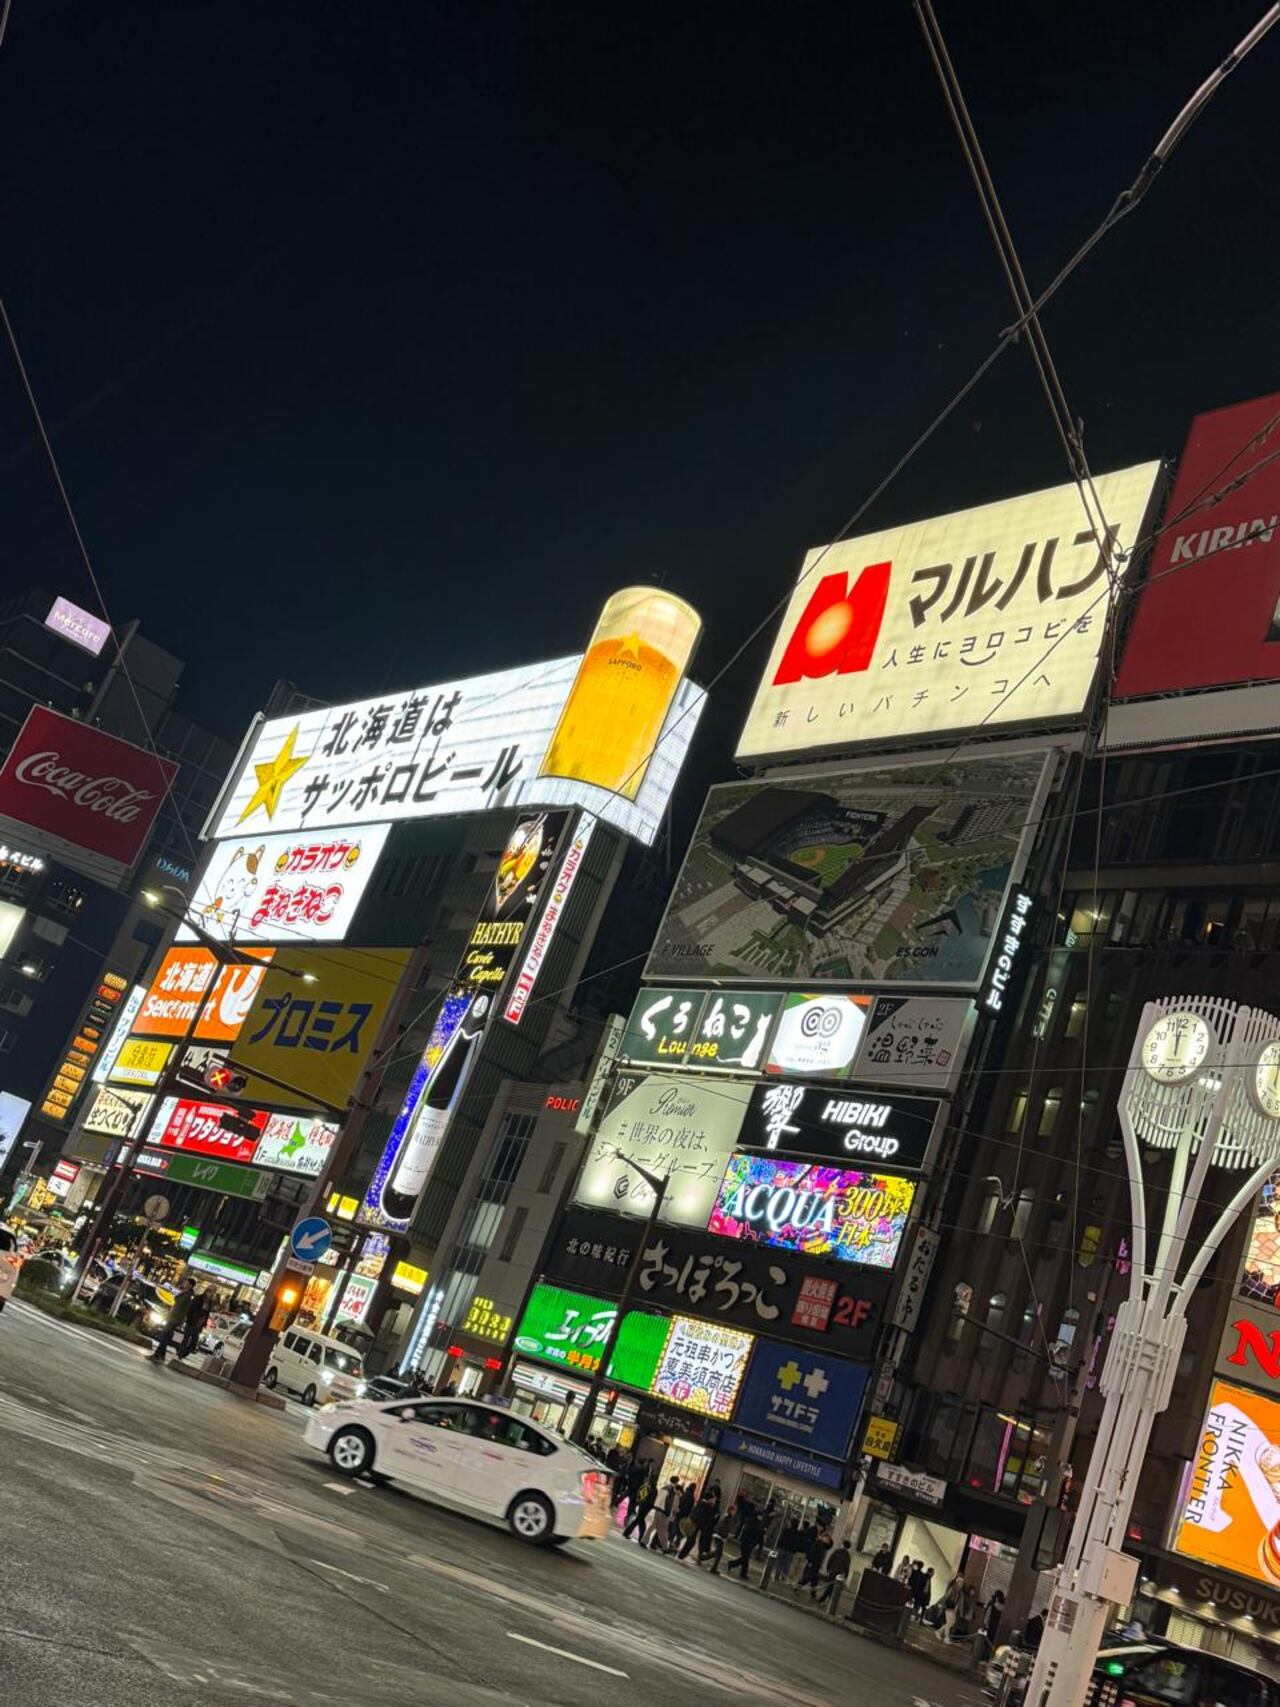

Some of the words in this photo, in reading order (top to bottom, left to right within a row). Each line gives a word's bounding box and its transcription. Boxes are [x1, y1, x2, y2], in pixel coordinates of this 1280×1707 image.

[1170, 515, 1278, 563] KIRIN
[909, 524, 1121, 628] マルハン
[882, 616, 1092, 668] 人生にヨロコビを
[608, 658, 642, 671] SAPPORO
[773, 674, 1050, 728] 新しいパチンコへ
[322, 690, 462, 757] 北海道は
[15, 752, 157, 822] Coca-Cola
[300, 744, 524, 818] サッポロビール
[286, 843, 349, 873] カラオケ
[250, 882, 344, 928] まねきねこ
[471, 922, 524, 944] HATHYR
[160, 961, 214, 992] 北海道
[249, 990, 373, 1053] プロミス
[641, 996, 750, 1040] くろねこ
[658, 1036, 718, 1056] Lounge
[616, 1078, 635, 1096] 9F
[822, 1099, 892, 1127] HIBIKI
[844, 1129, 899, 1158] Group
[722, 1182, 835, 1233] ACQUA
[566, 1238, 631, 1266] 北の味紀行
[640, 1239, 786, 1319] さっぽろっこ
[833, 1296, 872, 1327] 2F
[670, 1336, 735, 1368] 元祖串かつ
[662, 1357, 738, 1395] 恵美須商店
[1185, 1411, 1226, 1523] FRONTIER
[1217, 1419, 1248, 1490] NIKKA
[887, 1470, 935, 1493] すすきのビル
